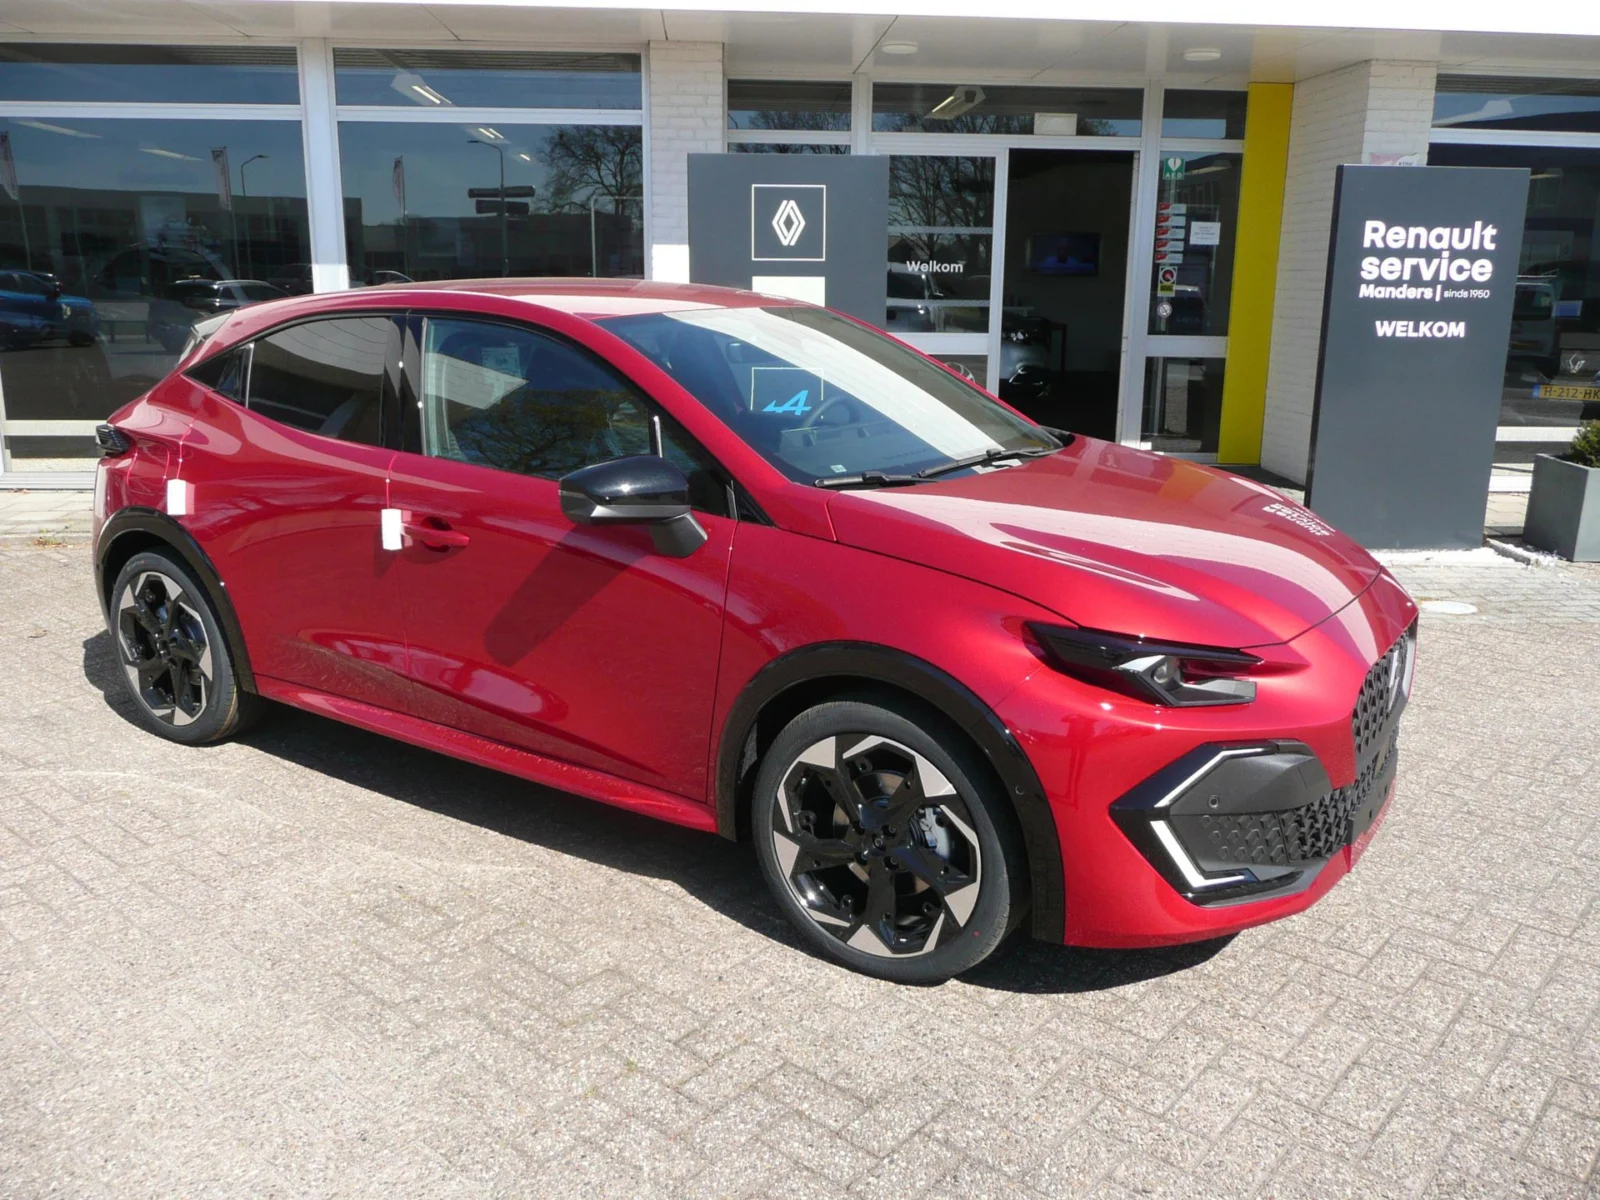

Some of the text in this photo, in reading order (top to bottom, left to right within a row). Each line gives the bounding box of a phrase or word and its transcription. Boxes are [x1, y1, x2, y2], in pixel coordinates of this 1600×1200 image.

[1363, 220, 1497, 250] Renault
[906, 260, 964, 273] Welkom
[1360, 250, 1493, 282] service
[1443, 289, 1469, 299] sinds
[1469, 289, 1490, 299] 1950
[1375, 320, 1465, 338] WELKOM
